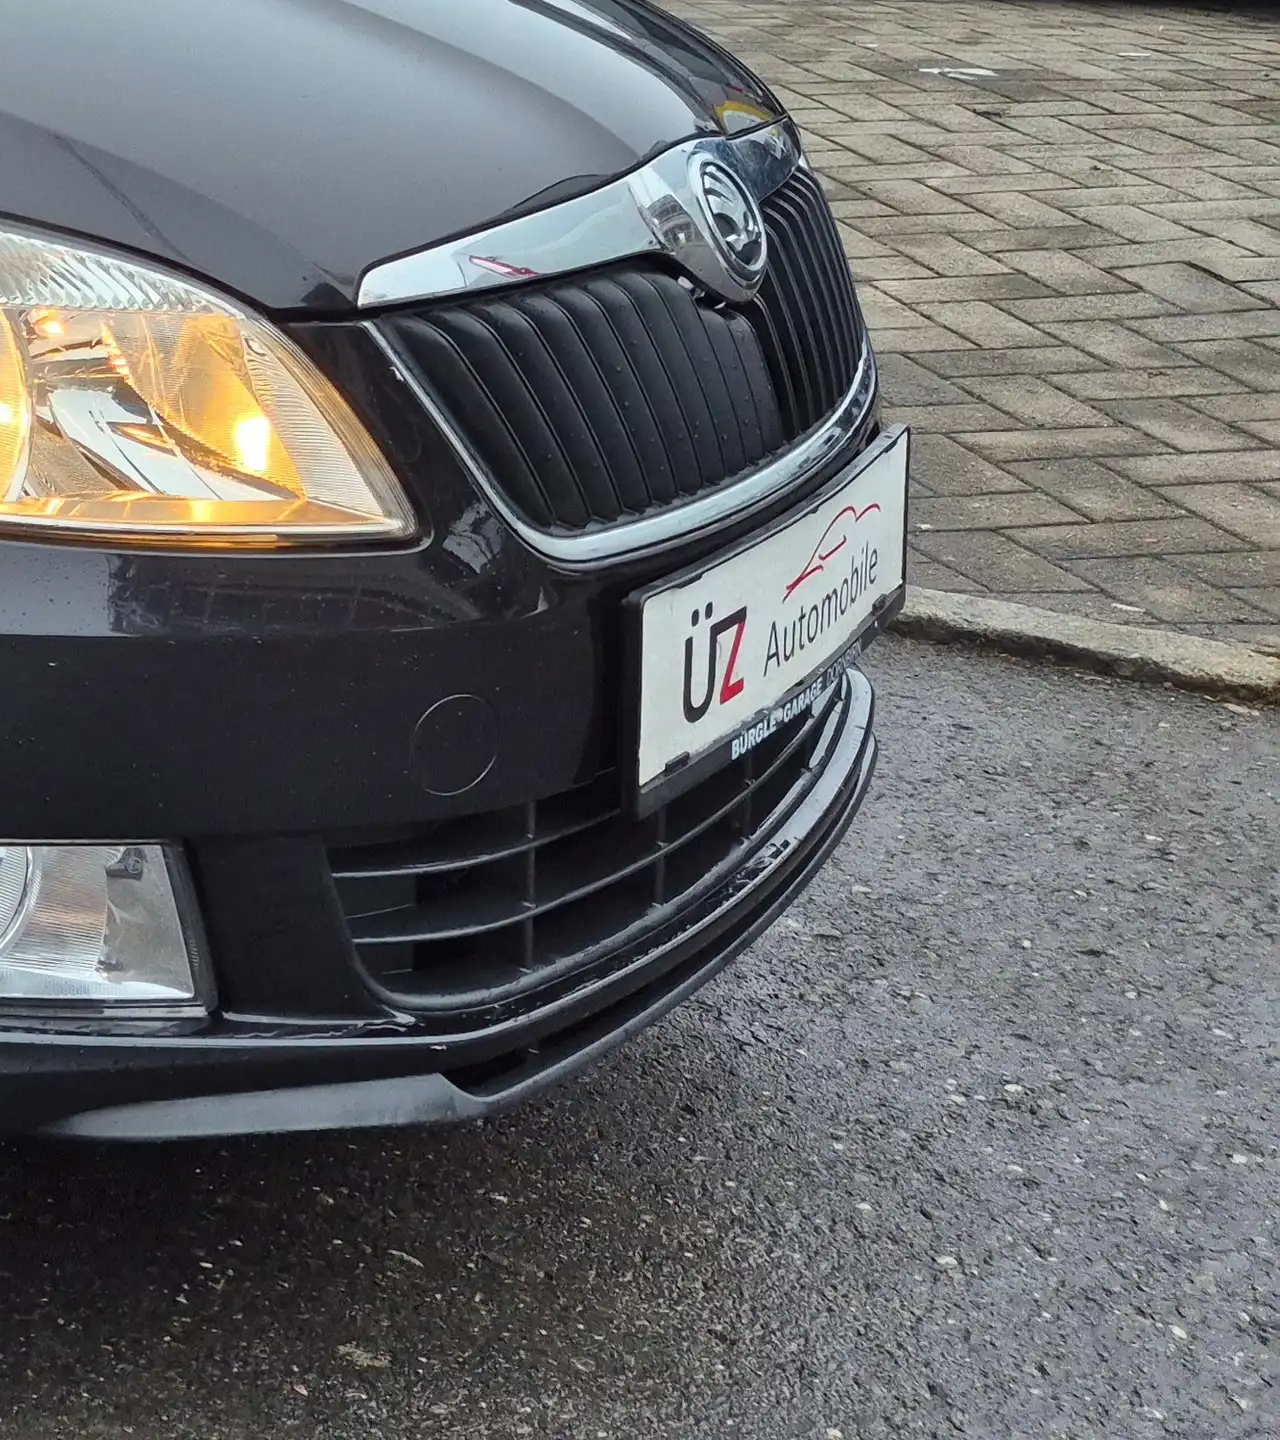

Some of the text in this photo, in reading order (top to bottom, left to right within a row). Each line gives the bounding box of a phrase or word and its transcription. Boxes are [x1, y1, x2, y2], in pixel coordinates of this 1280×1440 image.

[682, 541, 878, 723] ÜZ Automobile
[783, 677, 823, 724] GARAGE
